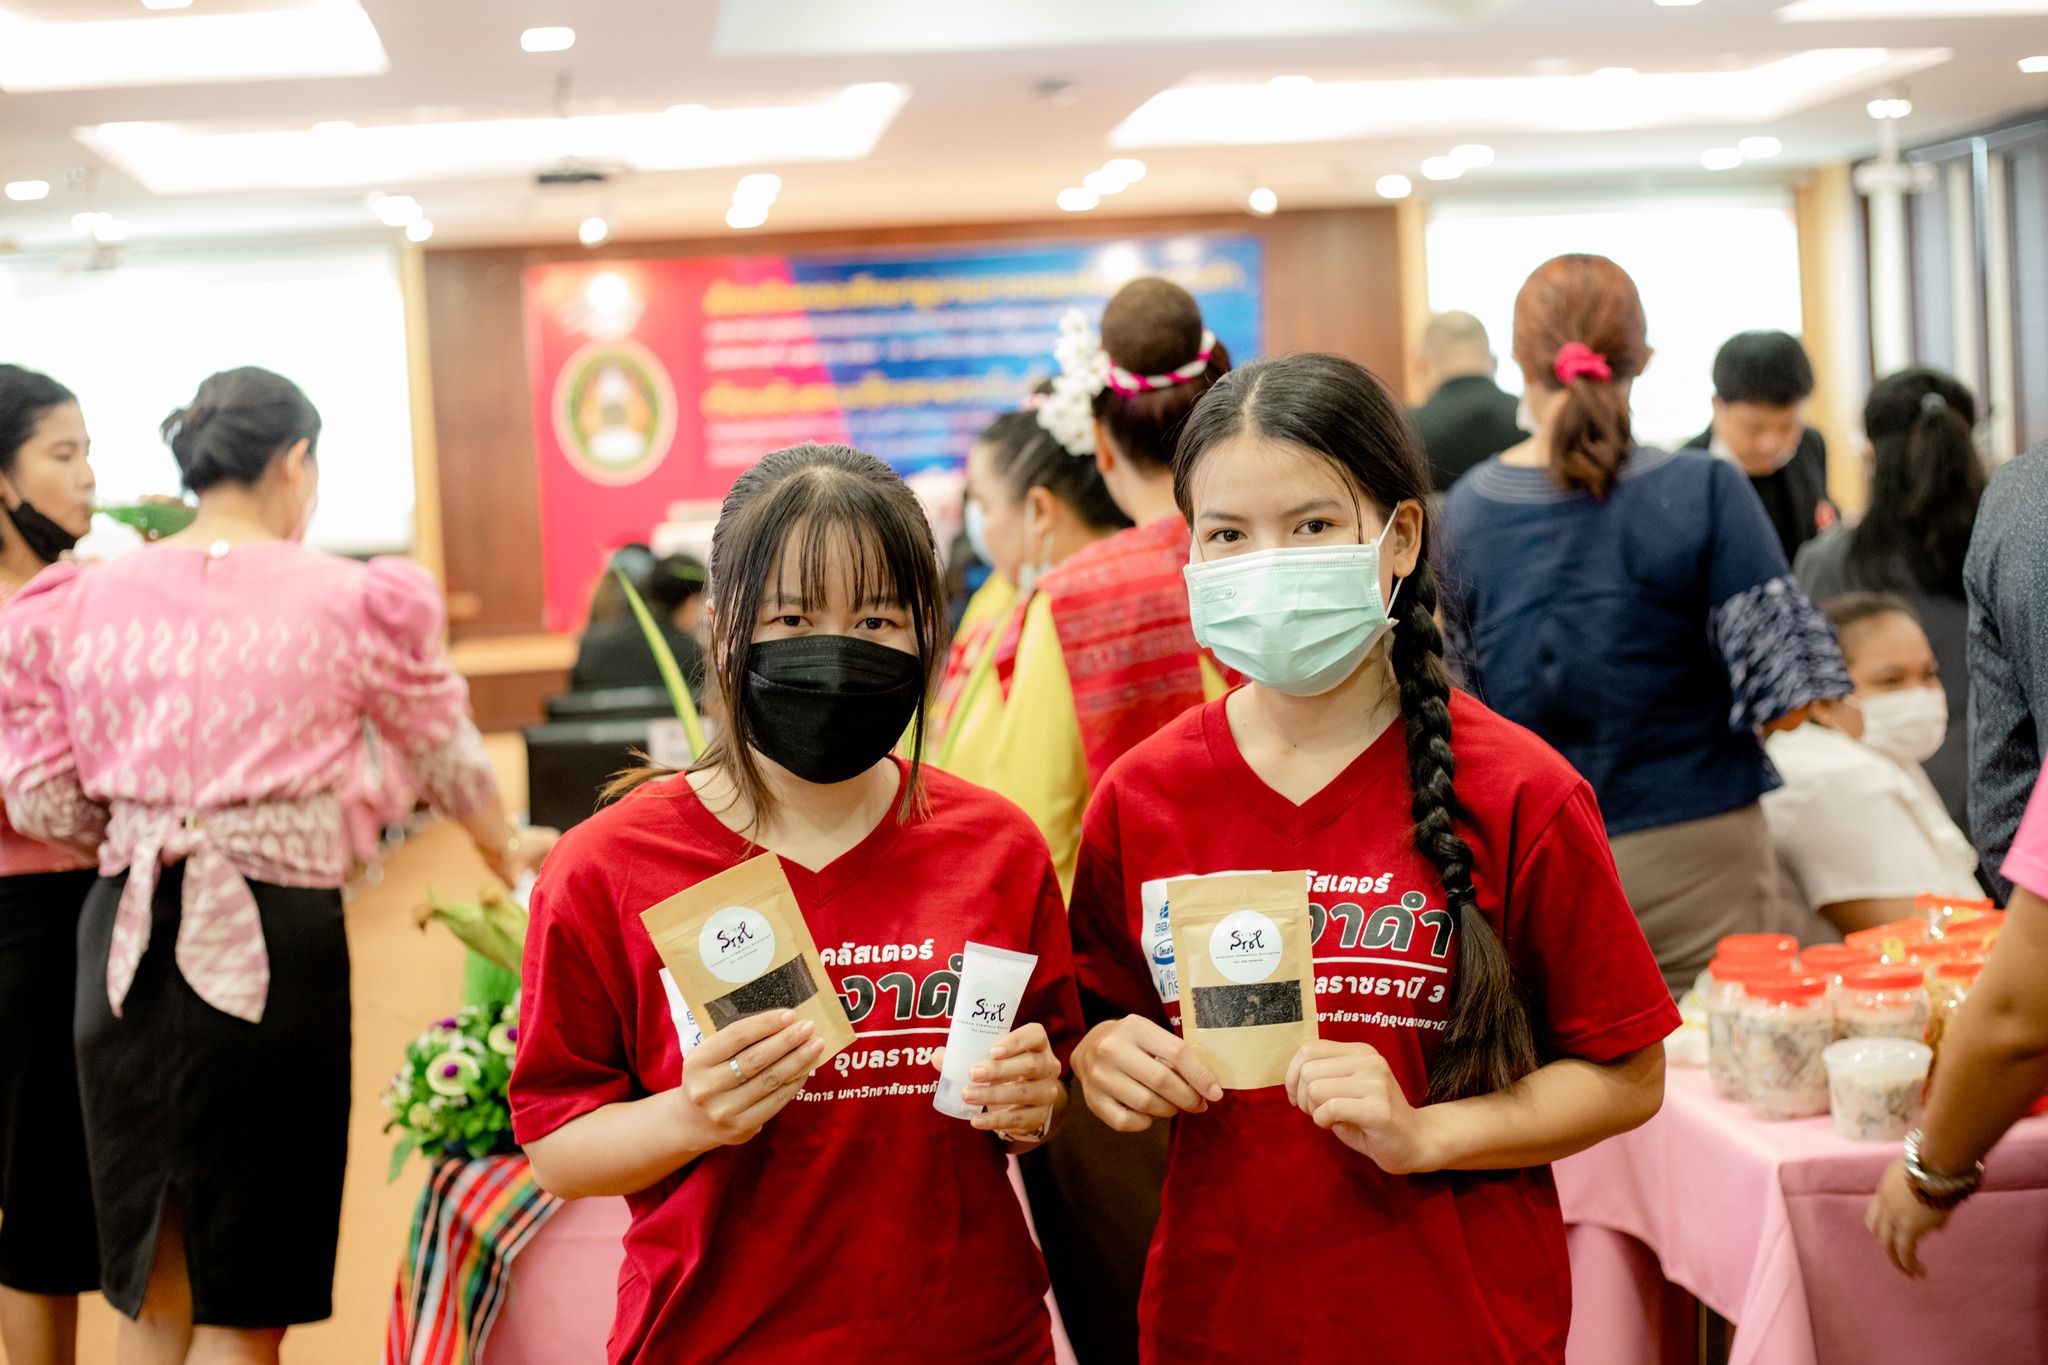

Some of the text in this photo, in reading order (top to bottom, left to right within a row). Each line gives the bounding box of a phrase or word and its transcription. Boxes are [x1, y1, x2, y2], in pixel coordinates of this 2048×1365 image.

[819, 938, 935, 967] คลัสเตอร์
[1314, 975, 1446, 1003] ลราชธานี 3
[792, 1080, 939, 1103] จัดการ มหาวิทยาลัยราชภั
